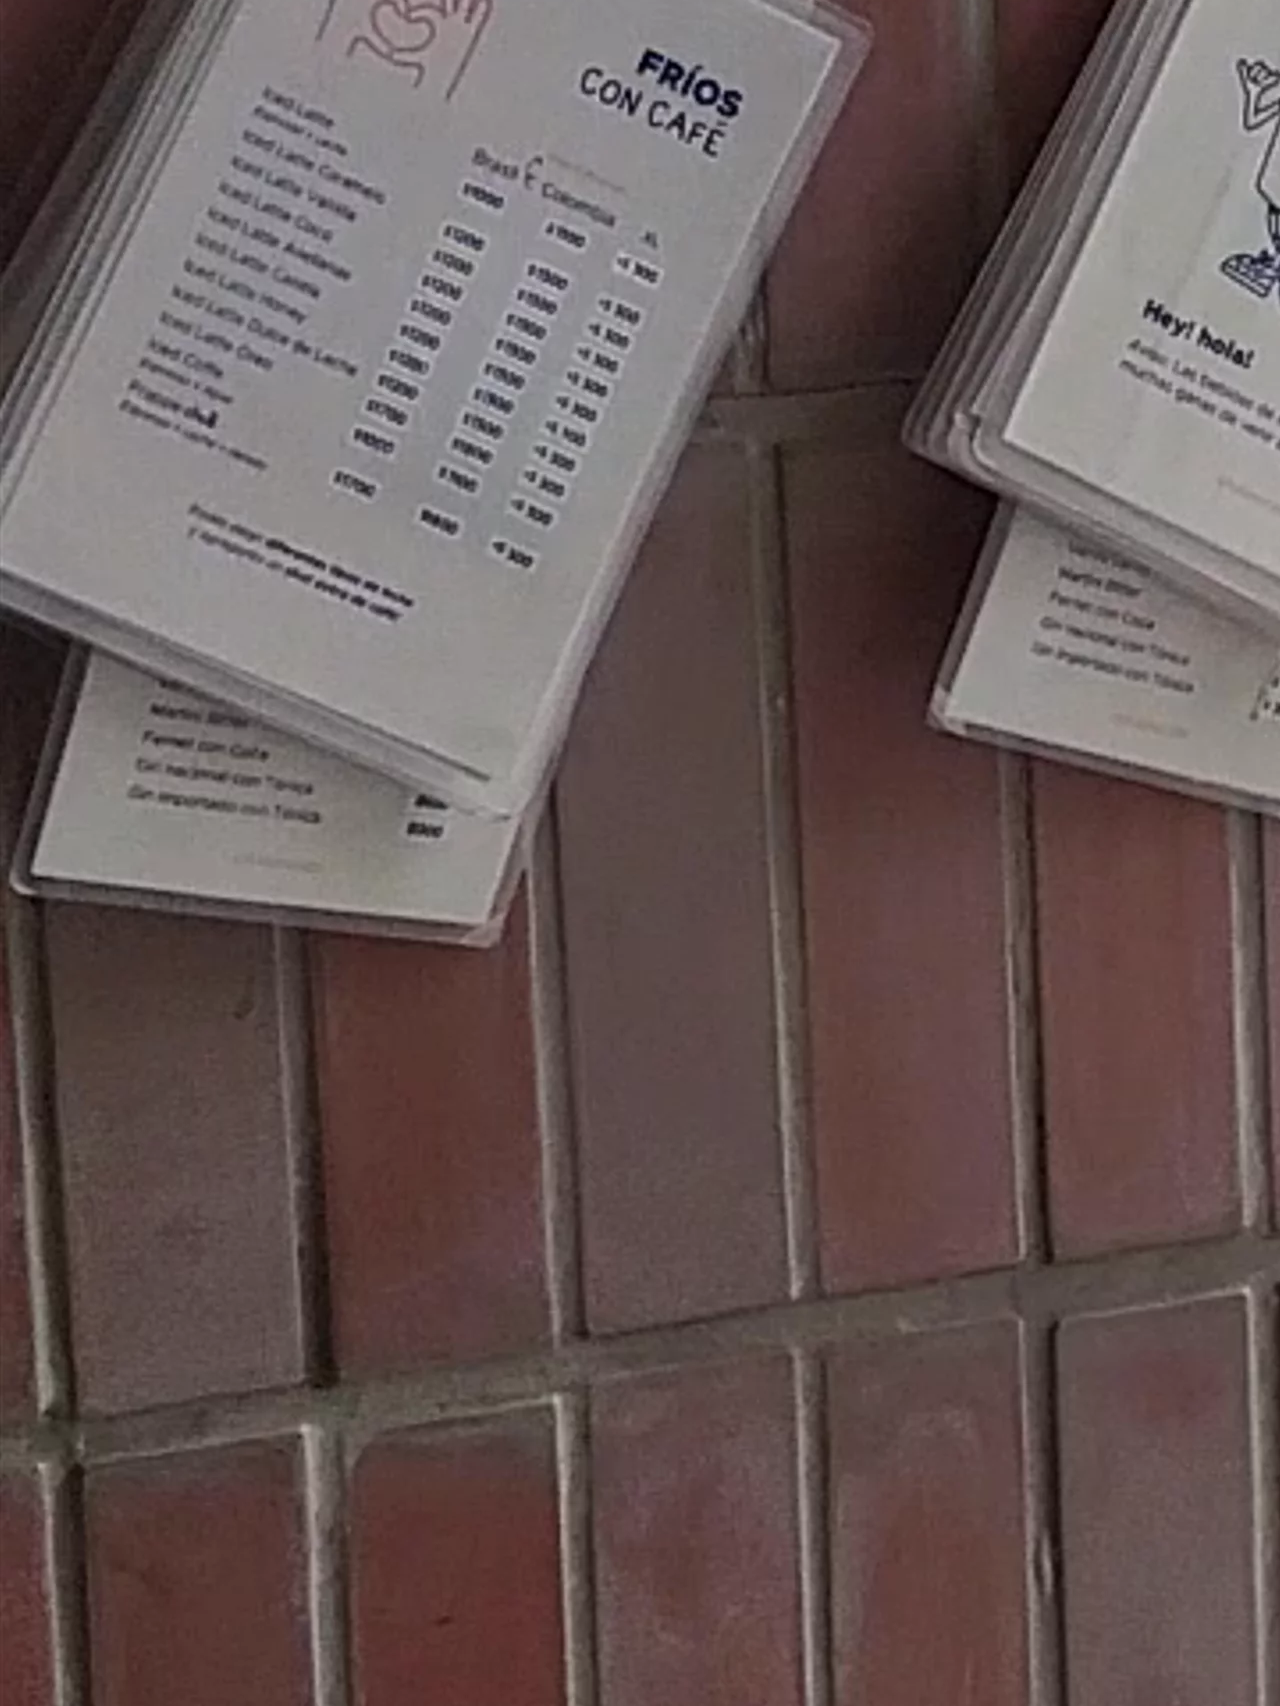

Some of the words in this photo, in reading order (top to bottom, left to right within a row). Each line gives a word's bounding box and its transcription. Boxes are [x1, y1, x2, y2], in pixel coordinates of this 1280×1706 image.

[579, 67, 643, 116] CON
[647, 99, 727, 157] CAFÉ
[636, 49, 742, 117] FRÍOS
[1142, 298, 1195, 339] Hey!
[1196, 326, 1254, 369] hola!
